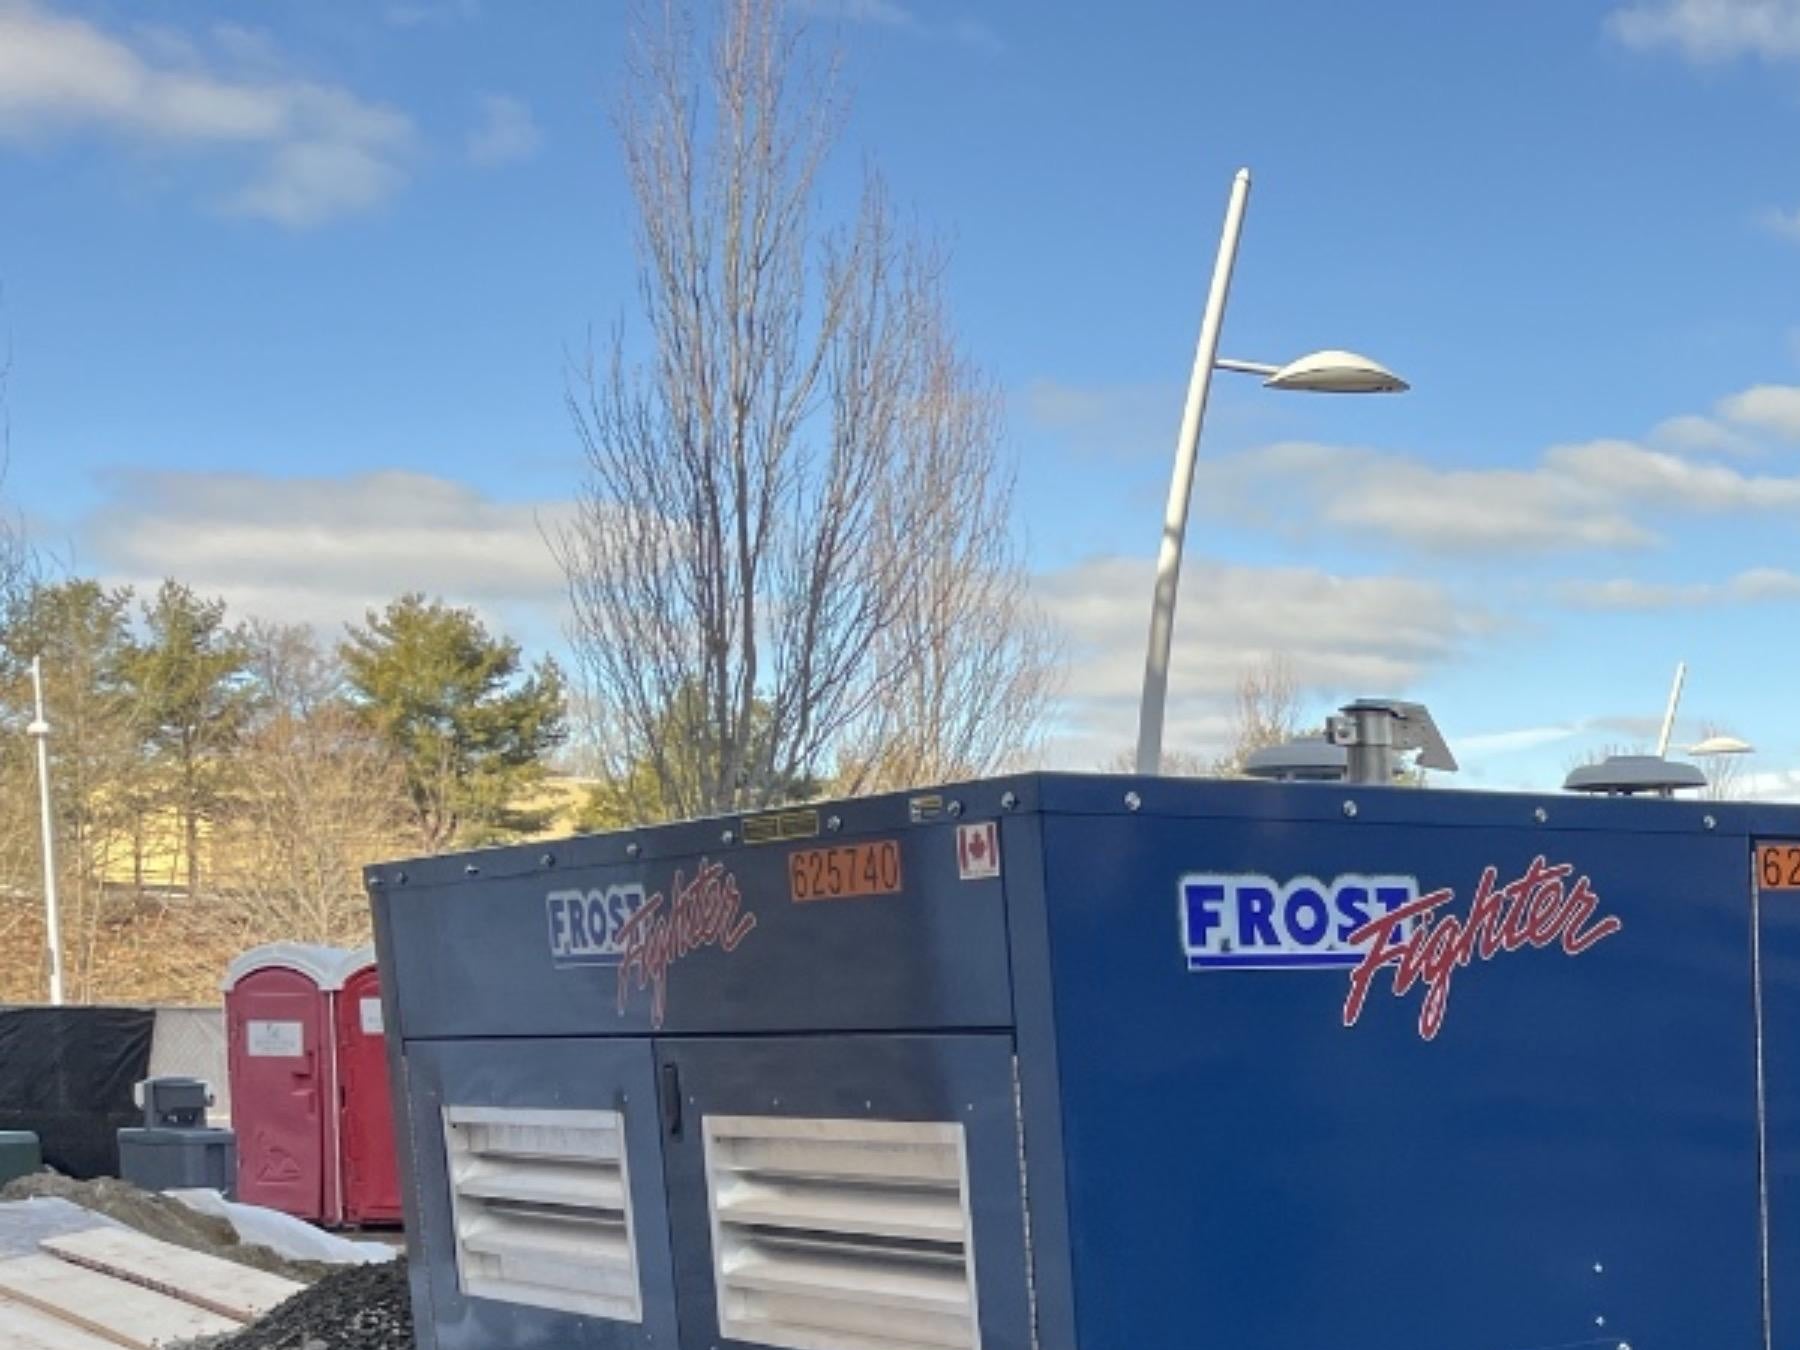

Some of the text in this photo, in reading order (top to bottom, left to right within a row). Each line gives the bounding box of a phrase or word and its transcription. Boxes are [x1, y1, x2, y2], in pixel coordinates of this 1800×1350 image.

[550, 856, 757, 1029] FROST Fighter
[791, 841, 898, 899] 625740
[1184, 855, 1622, 1041] FROST Fighter
